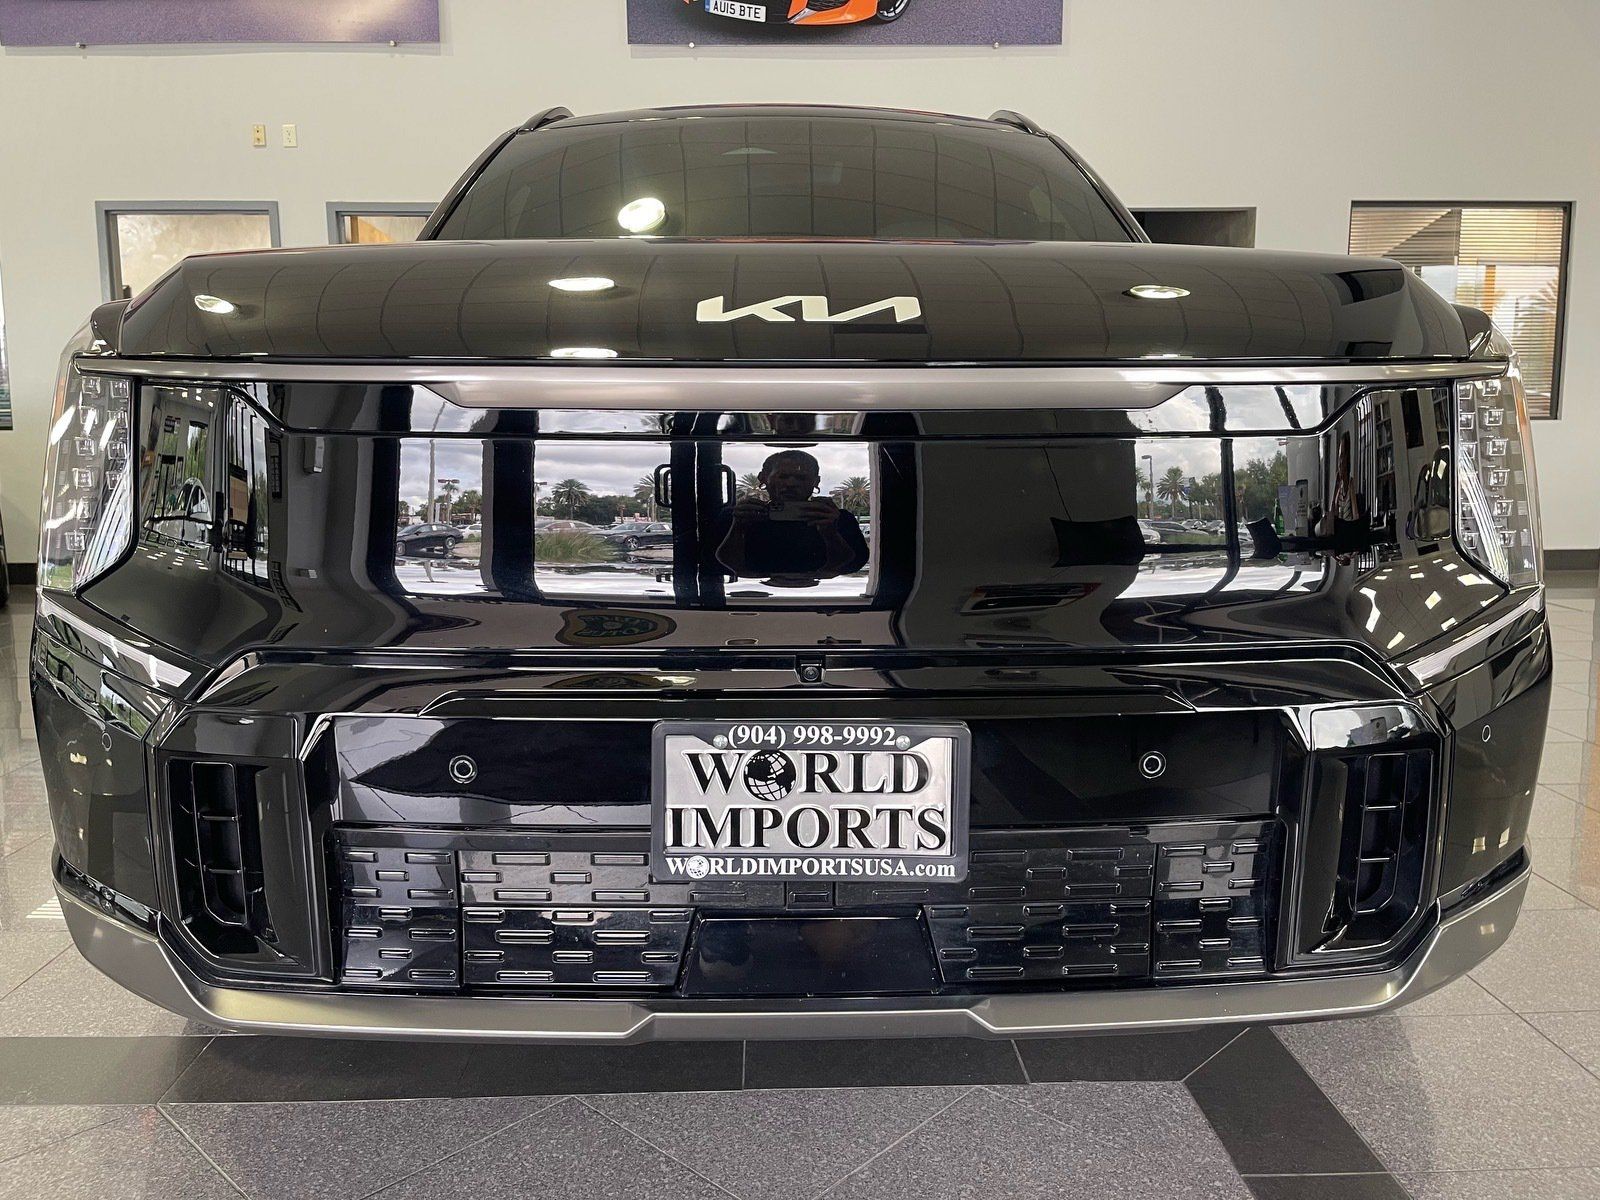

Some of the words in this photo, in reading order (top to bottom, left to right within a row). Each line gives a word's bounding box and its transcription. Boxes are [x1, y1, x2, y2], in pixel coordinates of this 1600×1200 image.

[713, 0, 736, 14] AU15
[739, 5, 761, 18] BTE
[696, 295, 921, 322] KIA
[728, 725, 787, 749] (904)
[793, 726, 896, 747] 998-9992
[667, 806, 946, 851] IMPORTS
